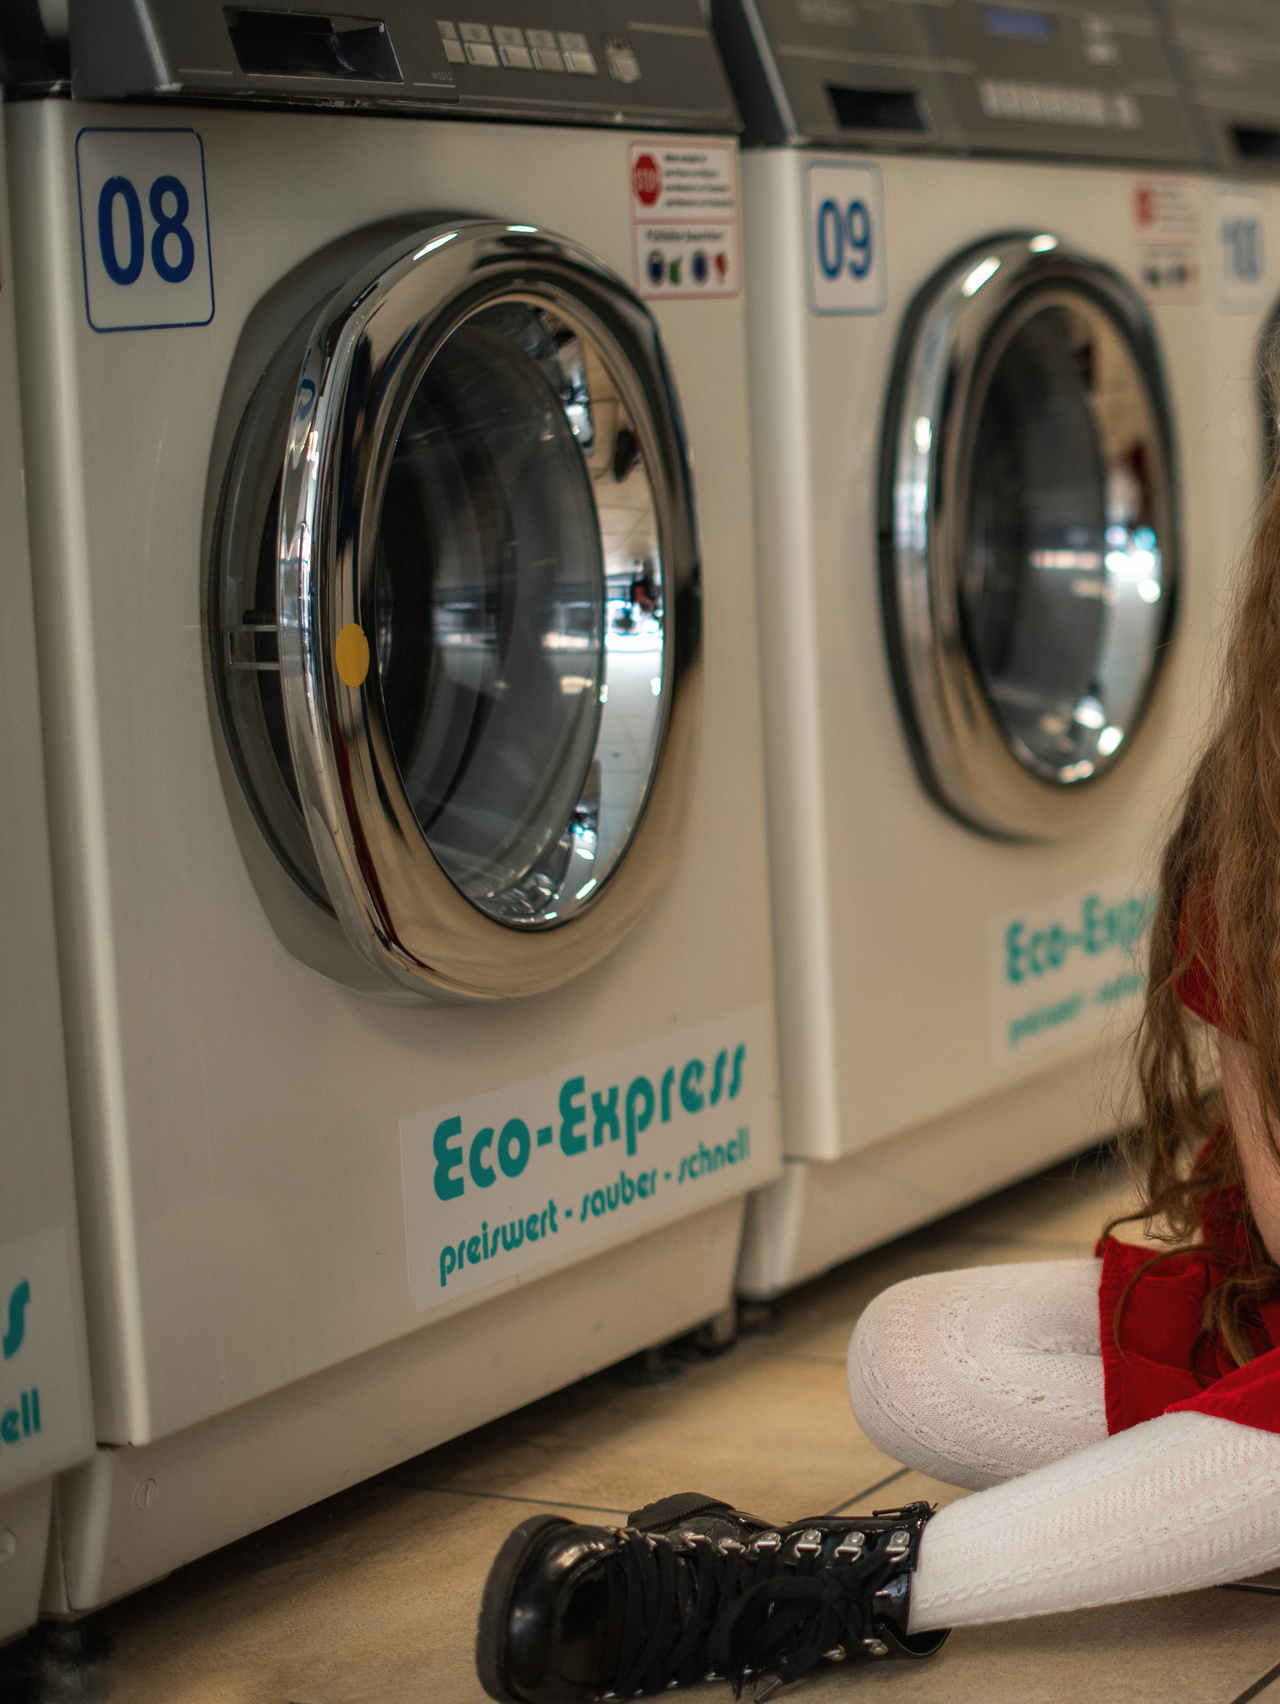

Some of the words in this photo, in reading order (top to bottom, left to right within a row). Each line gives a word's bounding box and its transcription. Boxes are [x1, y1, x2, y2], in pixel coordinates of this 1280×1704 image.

[98, 175, 195, 285] 08
[817, 199, 872, 280] 09
[432, 1043, 746, 1201] Eco-Express
[439, 1199, 558, 1287] preiswert
[580, 1170, 658, 1223] sauber
[678, 1126, 751, 1184] schnell
